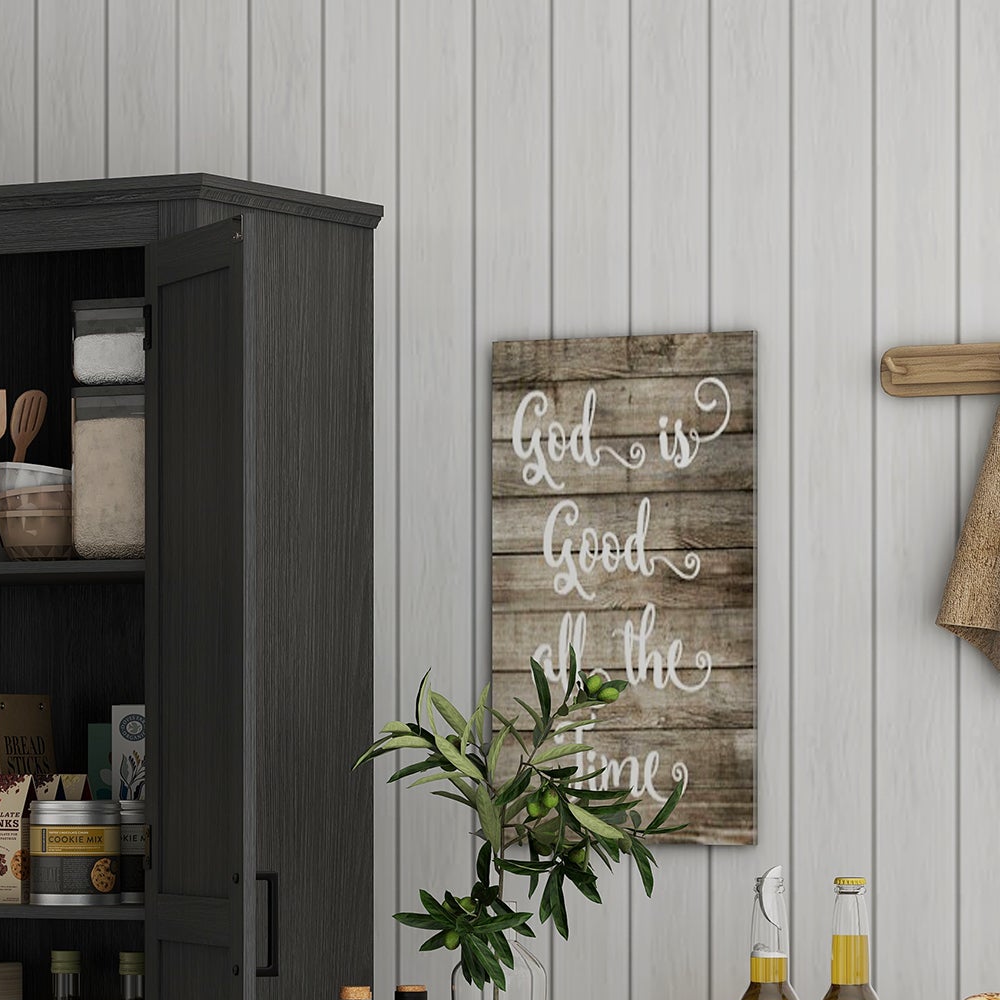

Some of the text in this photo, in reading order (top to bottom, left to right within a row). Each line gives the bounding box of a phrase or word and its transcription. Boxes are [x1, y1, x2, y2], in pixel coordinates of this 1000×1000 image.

[513, 377, 730, 489] God is
[543, 497, 700, 600] Good
[612, 603, 711, 692] the
[4, 735, 45, 755] BREAD
[7, 756, 52, 774] STICKS
[554, 712, 688, 803] Time
[48, 835, 103, 843] COOKIE MIX
[121, 834, 138, 842] KIE
